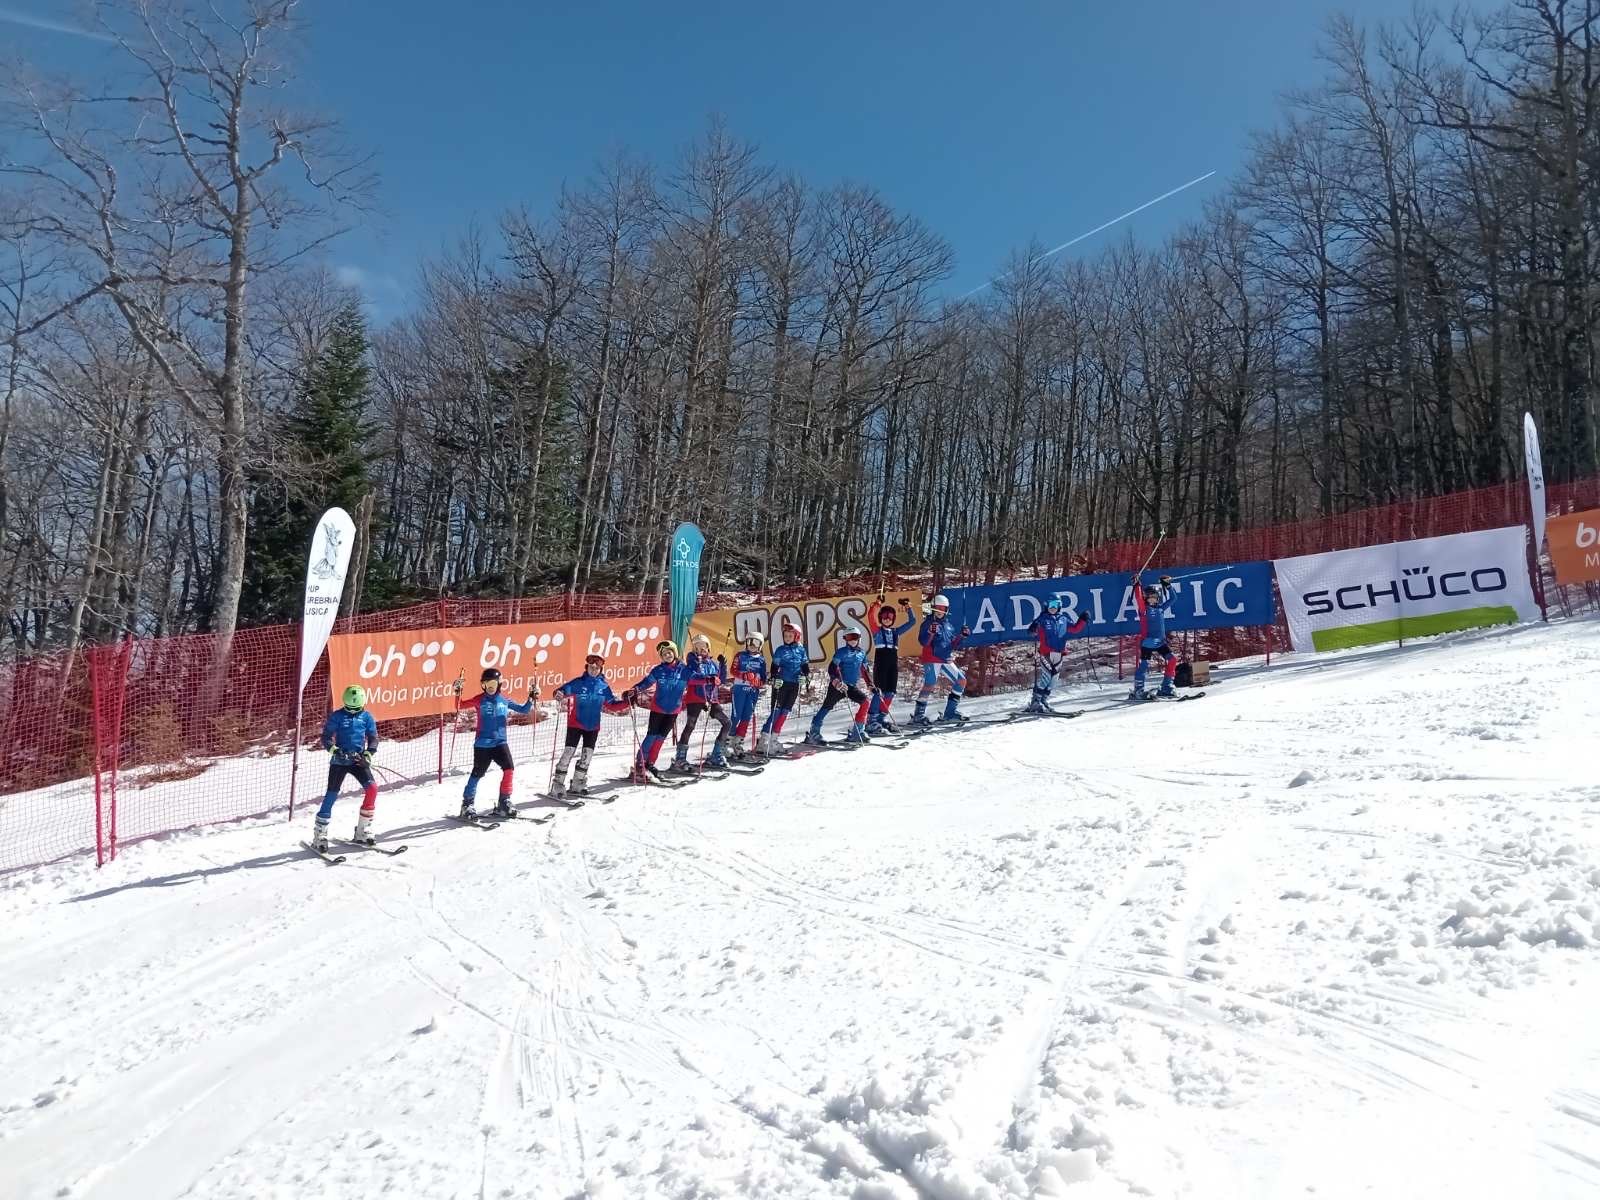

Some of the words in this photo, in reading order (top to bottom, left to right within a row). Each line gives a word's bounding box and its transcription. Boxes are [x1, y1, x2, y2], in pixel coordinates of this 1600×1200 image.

[1575, 522, 1600, 549] b
[1585, 552, 1600, 568] M
[1302, 566, 1507, 616] SCHÜCO
[587, 629, 623, 658] bh
[734, 598, 873, 664] TOPS
[359, 644, 407, 679] bh
[480, 636, 521, 669] bh
[500, 673, 523, 694] oja
[602, 664, 625, 684] oja
[627, 662, 656, 681] prič
[365, 684, 408, 707] Moja
